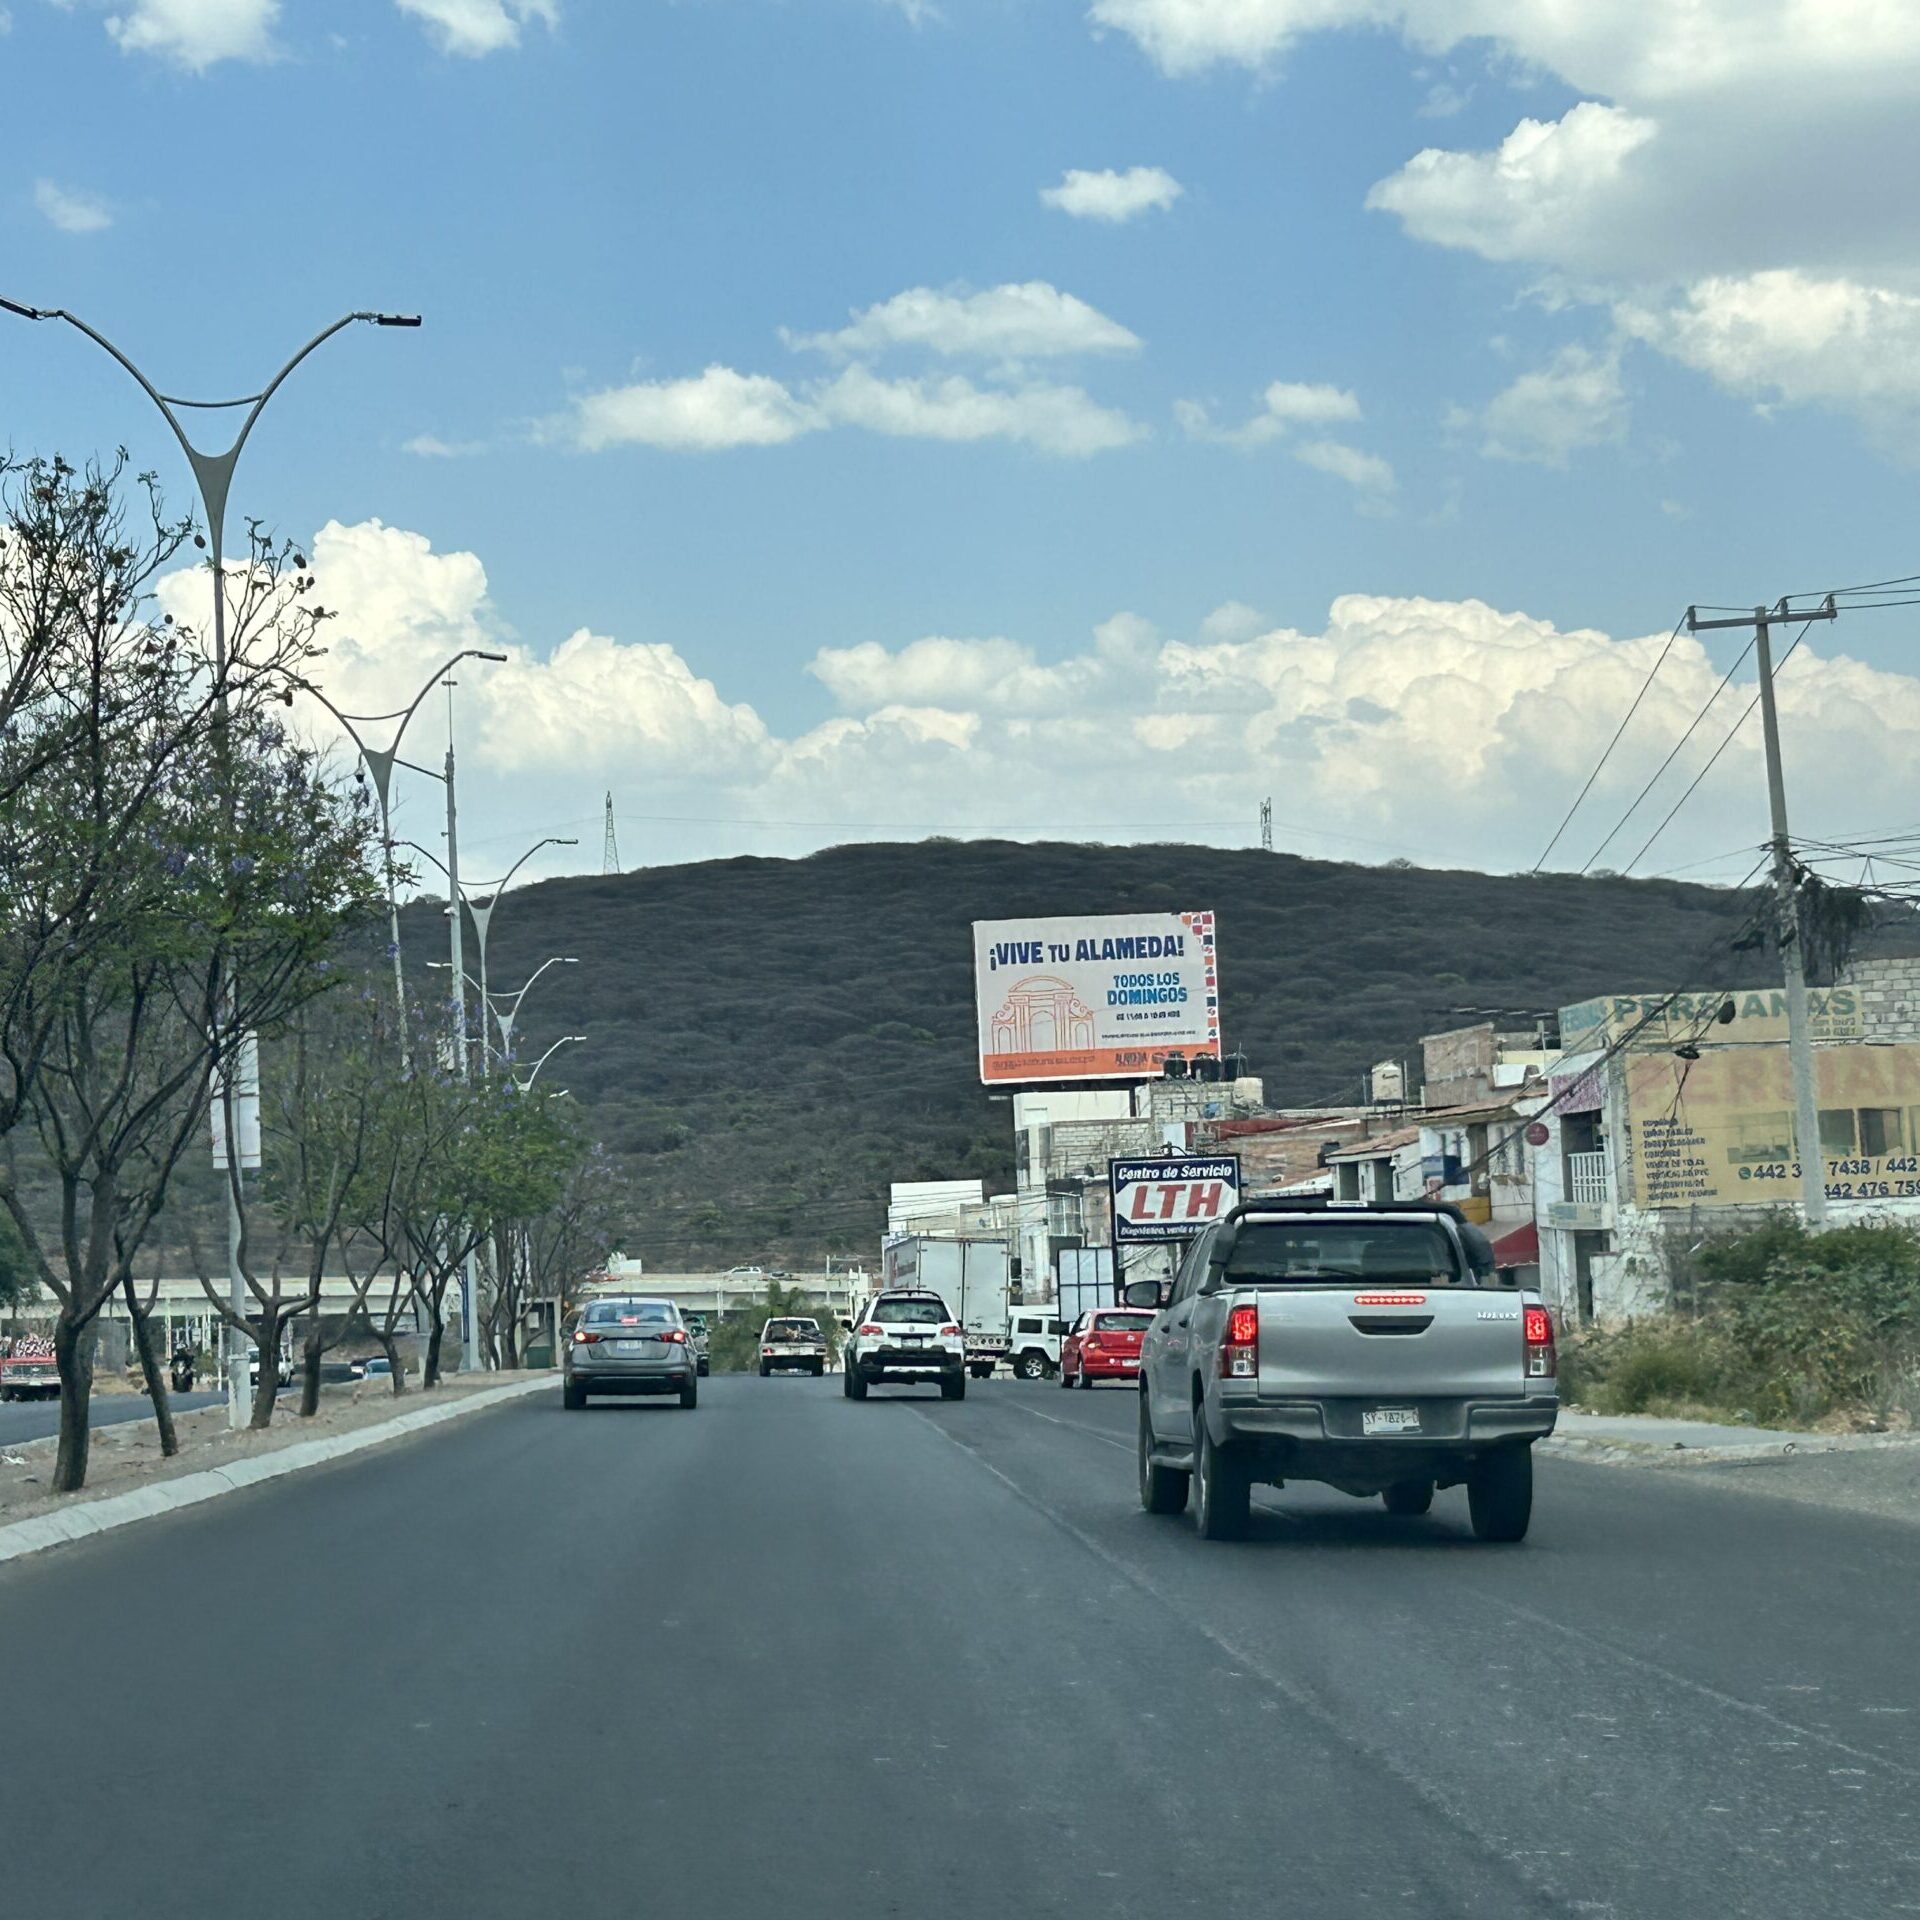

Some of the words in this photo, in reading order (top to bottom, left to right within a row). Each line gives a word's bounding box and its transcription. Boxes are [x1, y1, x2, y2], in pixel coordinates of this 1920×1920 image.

[990, 941, 1043, 970] ¡VIVE
[1048, 944, 1070, 963] TU
[1075, 935, 1184, 961] ALAMEDA!
[1113, 973, 1155, 988] TODOS
[1156, 972, 1180, 986] LOS
[1106, 987, 1188, 1006] DOMINGOS
[1118, 1167, 1160, 1180] Centro
[1162, 1166, 1178, 1179] de
[1180, 1164, 1233, 1178] Servicio
[1753, 1165, 1786, 1178] 442
[1886, 1157, 1917, 1172] 442
[1857, 1182, 1889, 1197] 476
[1130, 1183, 1223, 1219] LTH
